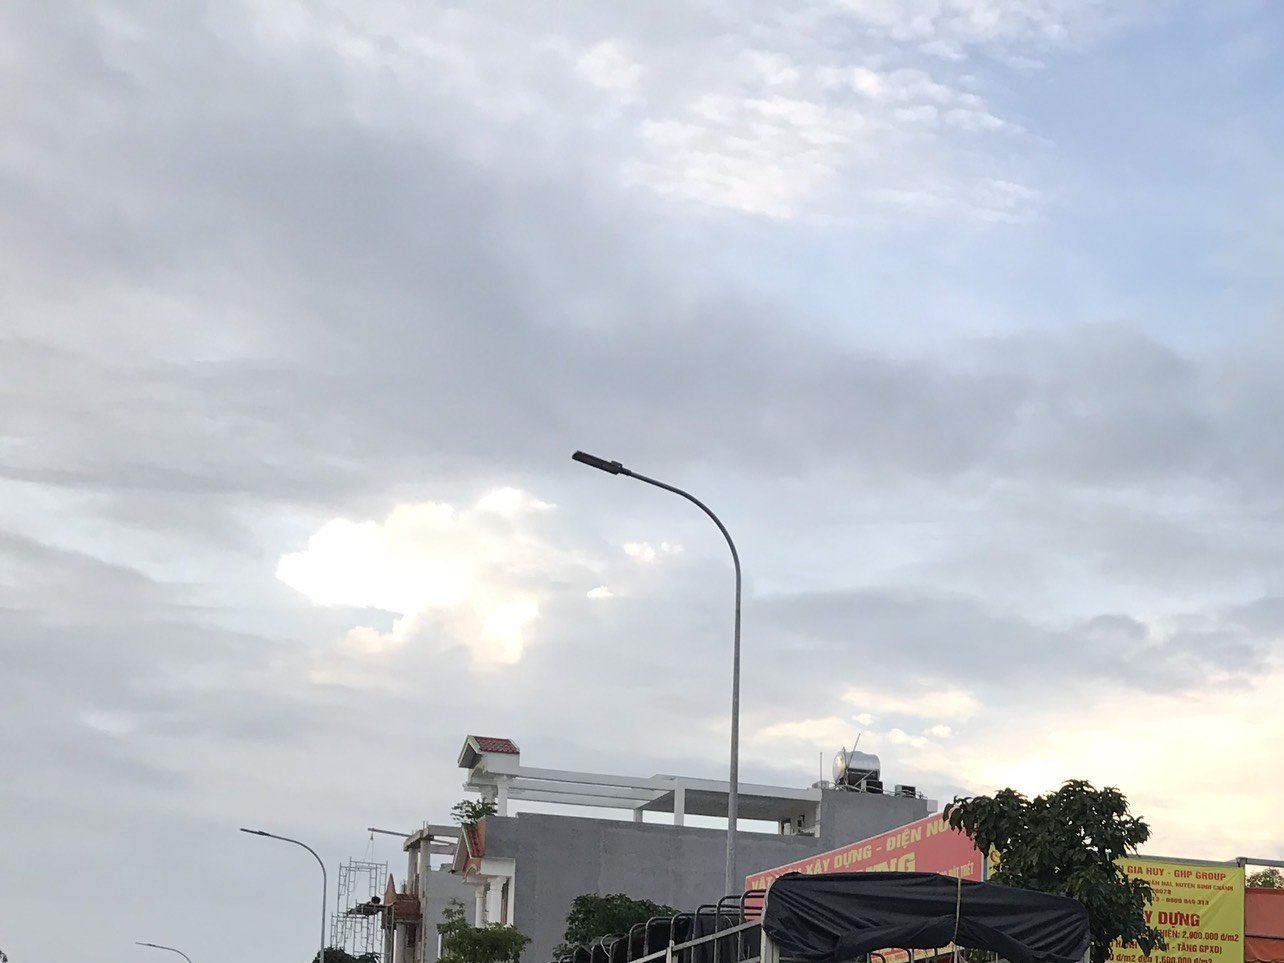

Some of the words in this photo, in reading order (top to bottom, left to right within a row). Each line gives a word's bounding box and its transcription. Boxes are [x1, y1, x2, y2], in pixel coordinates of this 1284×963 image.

[834, 845, 872, 868] DỰNG
[886, 827, 922, 849] ĐIỆN
[1127, 865, 1143, 874] GIA
[1146, 867, 1164, 876] HUY
[1174, 869, 1192, 878] GHP
[1196, 871, 1226, 881] GROUP
[1159, 911, 1200, 928] DỰNG
[1182, 931, 1218, 941] 2.900.000
[1220, 933, 1239, 942] đ/m2
[1116, 954, 1136, 963] đ/m2
